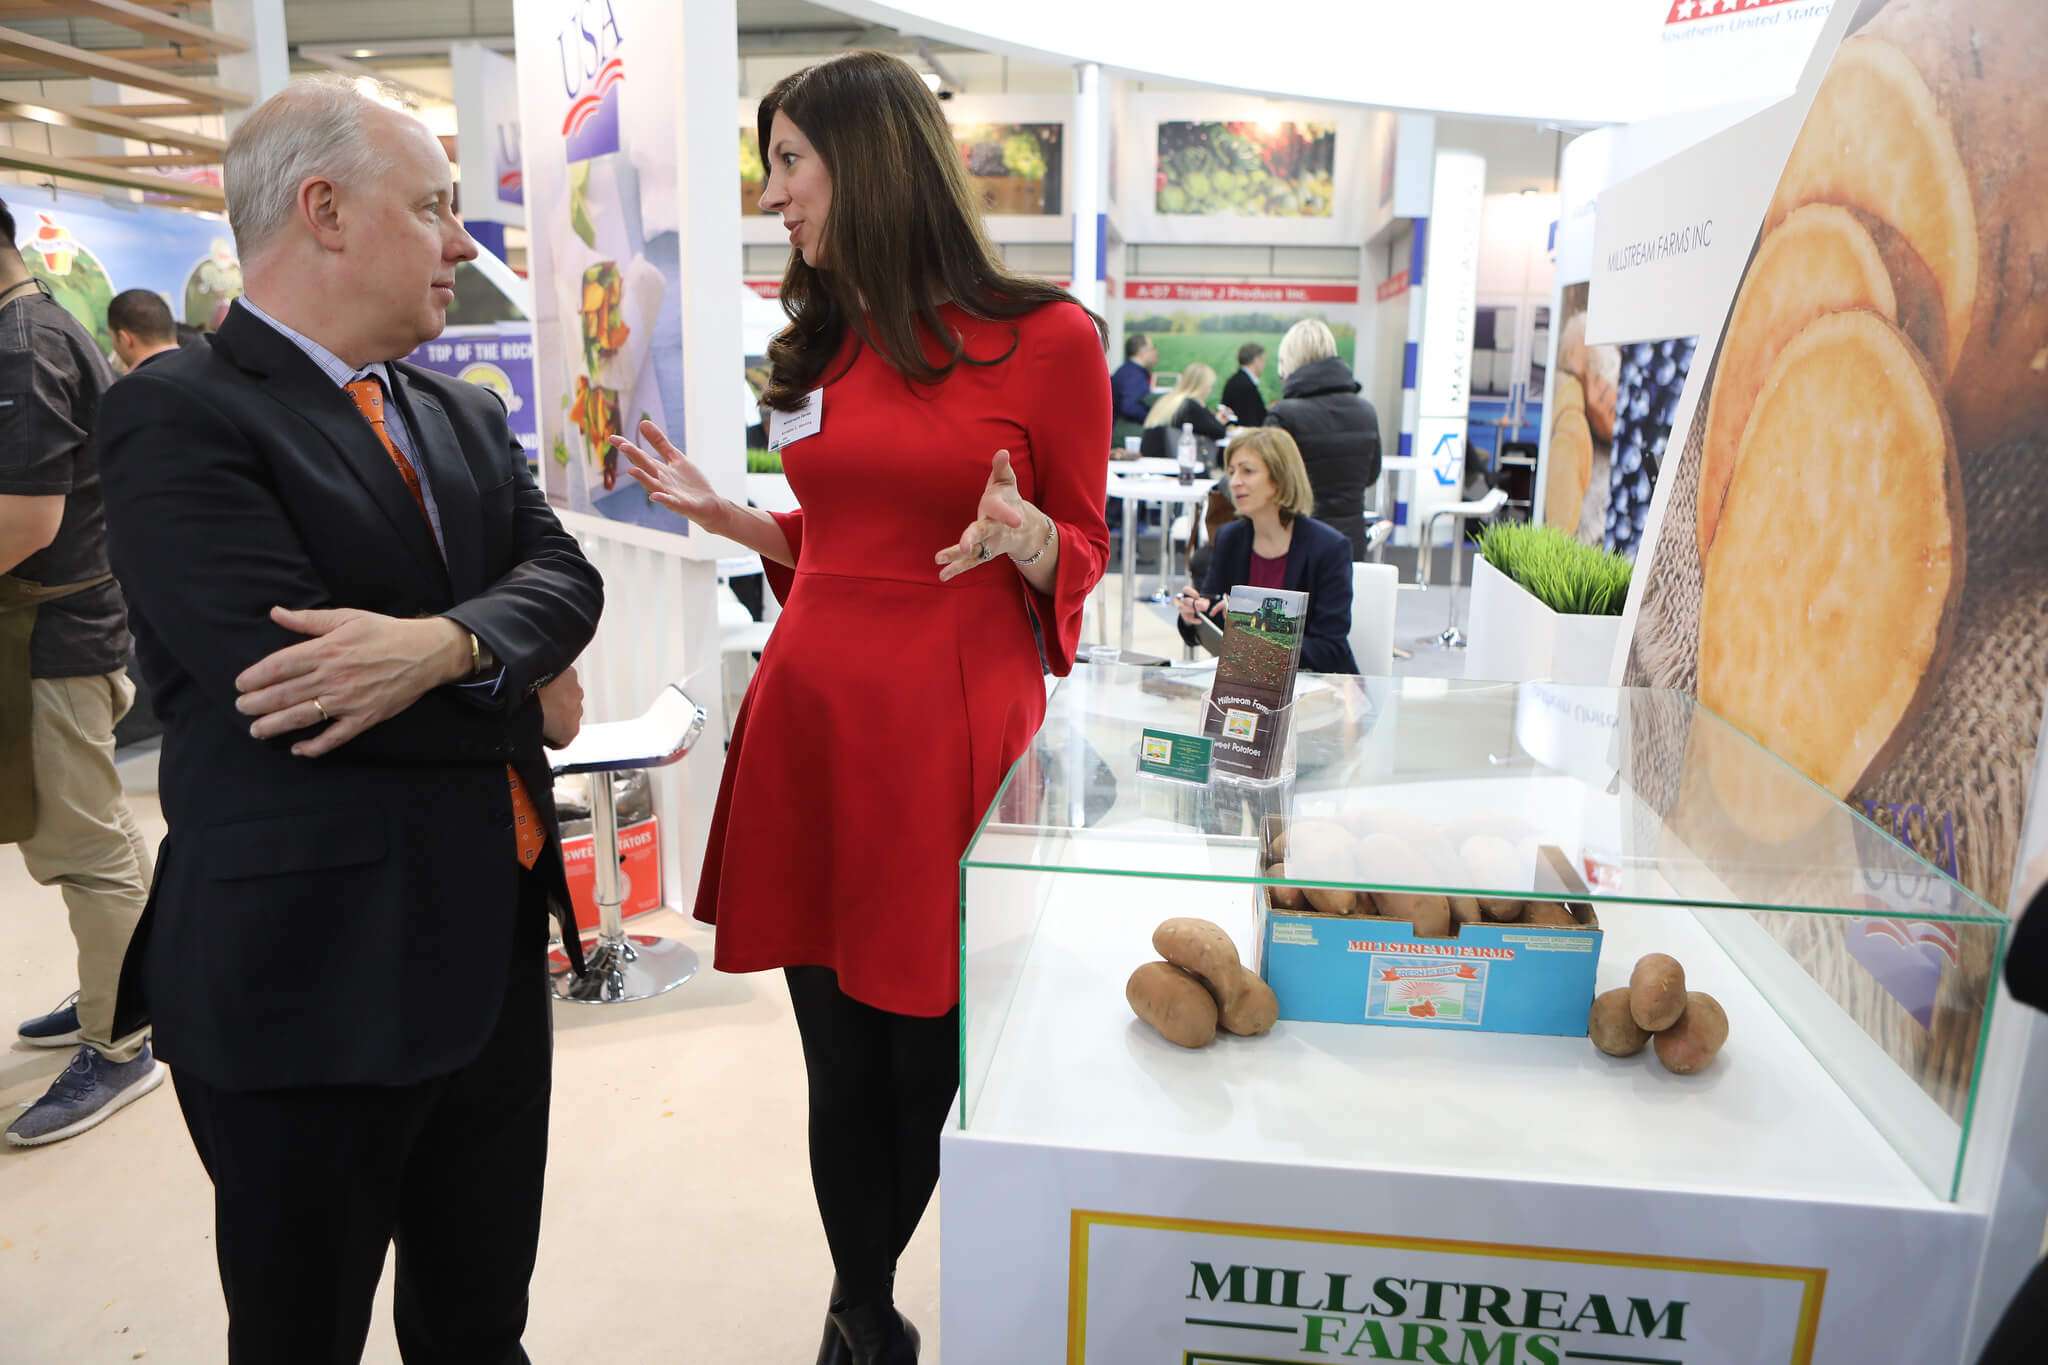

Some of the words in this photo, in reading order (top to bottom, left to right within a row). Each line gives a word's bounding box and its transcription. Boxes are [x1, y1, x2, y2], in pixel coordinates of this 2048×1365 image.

[1662, 25, 1725, 43] Southern
[1729, 12, 1779, 33] United
[1786, 4, 1832, 23] States
[556, 0, 625, 99] USA
[1607, 239, 1656, 273] MILLSTREAM
[1656, 226, 1690, 260] FARMS
[1691, 218, 1713, 250] INC
[1176, 285, 1213, 301] Triple
[1231, 286, 1283, 300] Produce
[428, 343, 453, 361] TOP
[455, 343, 472, 361] OF
[475, 342, 500, 361] THE
[1217, 696, 1251, 707] Millstream
[1214, 740, 1231, 751] weet
[1232, 742, 1262, 758] Potatoes
[564, 846, 594, 861] SWEE
[1347, 940, 1456, 956] MILLSTREAM
[1459, 945, 1516, 960] FARMS
[1185, 1260, 1690, 1341] MILLSTREAM
[1298, 1312, 1561, 1365] FARMS
